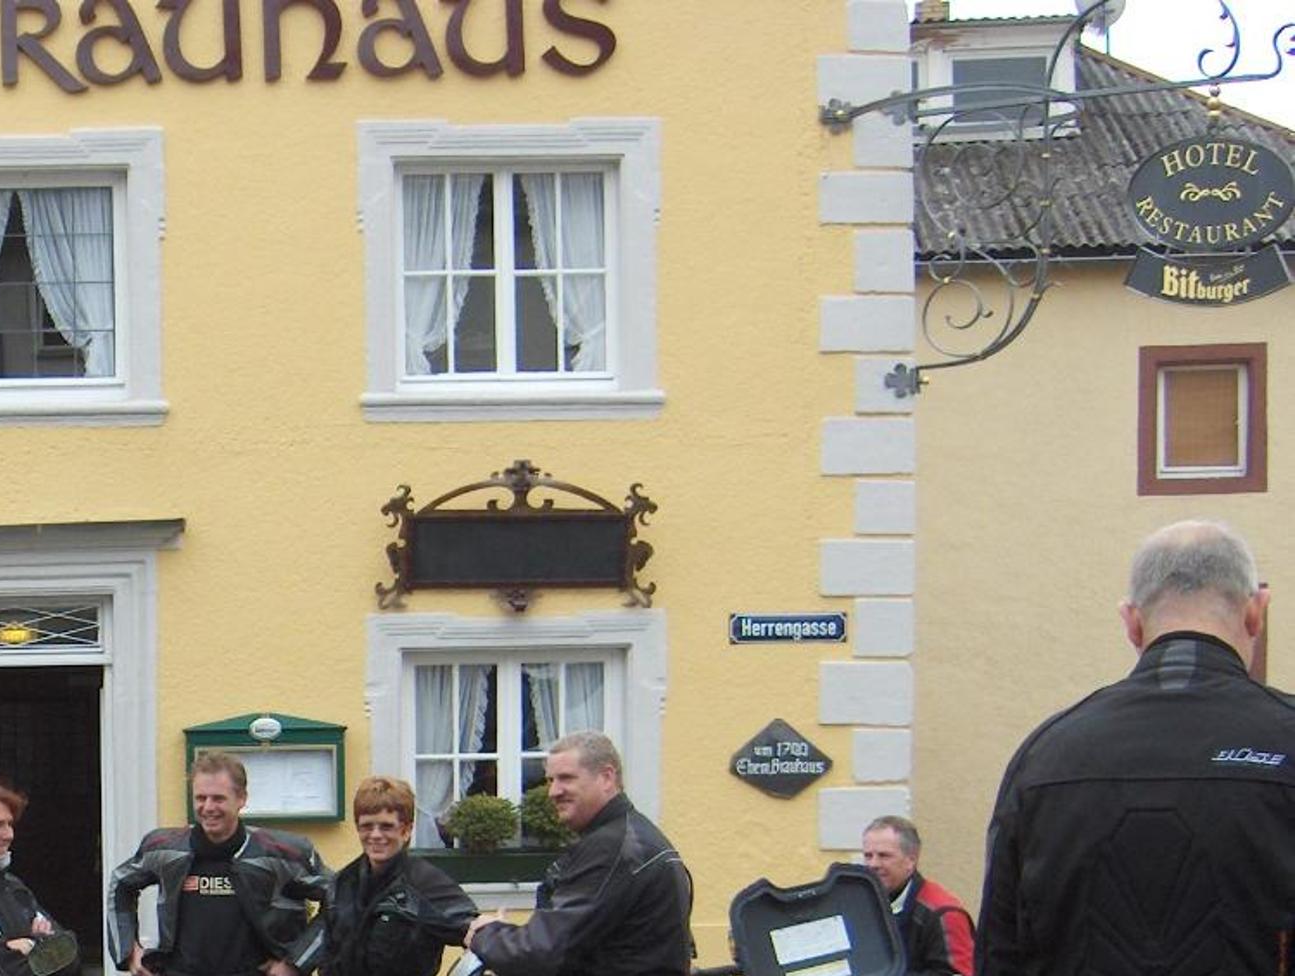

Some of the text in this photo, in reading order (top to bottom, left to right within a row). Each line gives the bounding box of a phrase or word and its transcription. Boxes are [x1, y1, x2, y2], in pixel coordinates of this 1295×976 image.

[1160, 142, 1260, 177] HOTEL
[1135, 191, 1285, 244] RESTAURANT
[1160, 265, 1251, 303] Bitburger
[740, 617, 837, 641] Herrengasse
